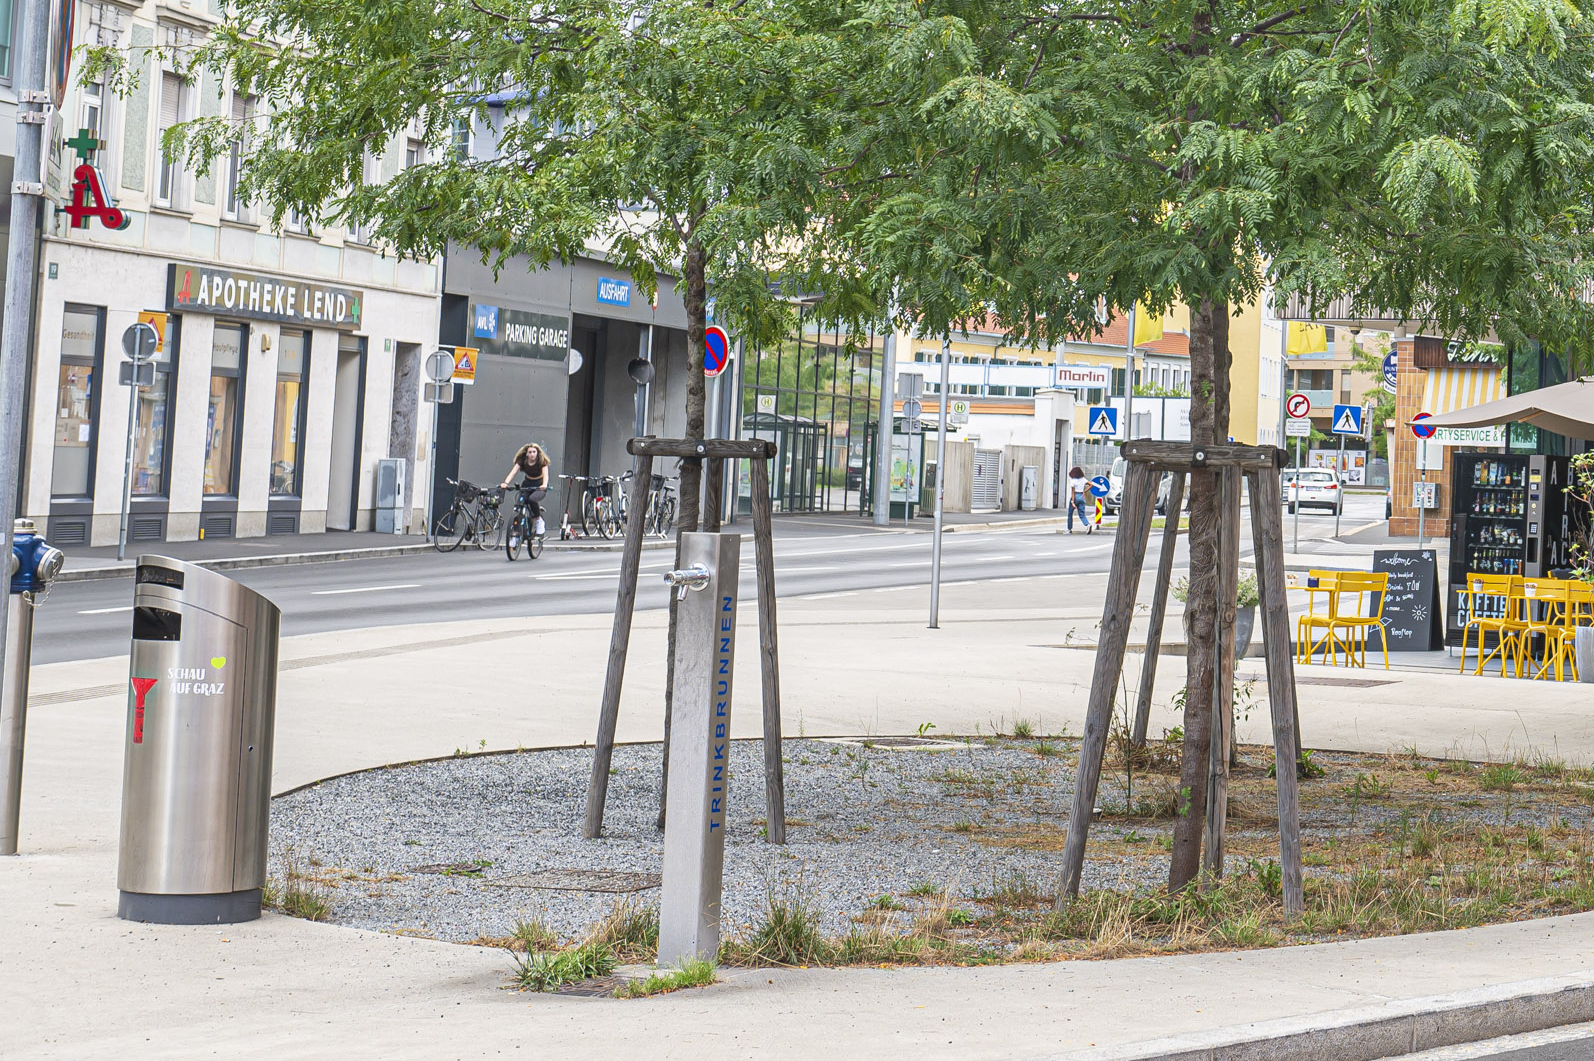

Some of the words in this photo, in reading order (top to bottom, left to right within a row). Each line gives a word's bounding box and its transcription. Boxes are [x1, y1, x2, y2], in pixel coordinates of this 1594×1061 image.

[197, 274, 296, 317] APOTHEKE
[303, 289, 347, 322] LEND
[599, 282, 629, 302] AUSFAHRT
[477, 315, 488, 330] AVL
[505, 323, 537, 346] PARKING
[538, 327, 568, 348] GARAGE
[1433, 429, 1491, 442] ARTYSERVICE
[168, 667, 206, 681] SCHAU
[169, 683, 192, 695] AUF
[193, 682, 225, 696] GRAZ
[709, 595, 733, 833] TRINKBRUNNEN
